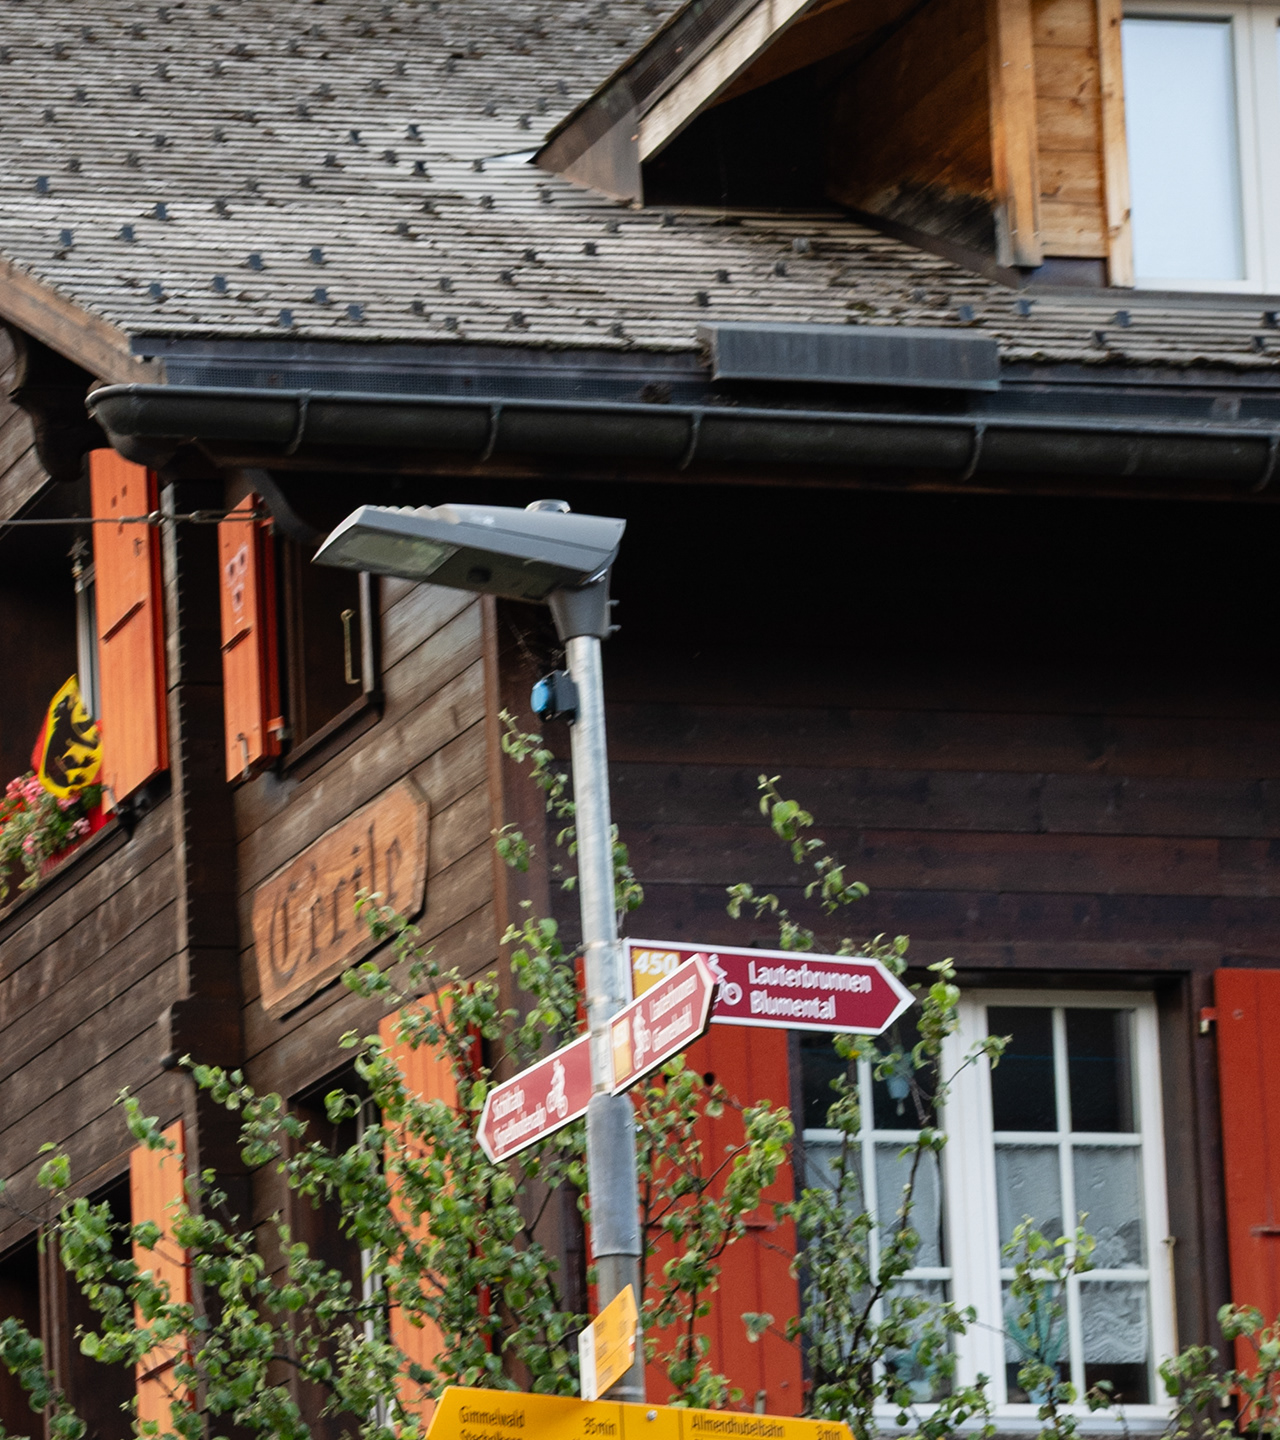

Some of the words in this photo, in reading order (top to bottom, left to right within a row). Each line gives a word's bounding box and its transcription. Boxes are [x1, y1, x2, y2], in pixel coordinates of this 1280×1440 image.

[633, 951, 679, 975] 450
[748, 960, 872, 993] Lauterbrunnen
[750, 990, 836, 1020] Blumental
[459, 1405, 525, 1428] Gimmelwald
